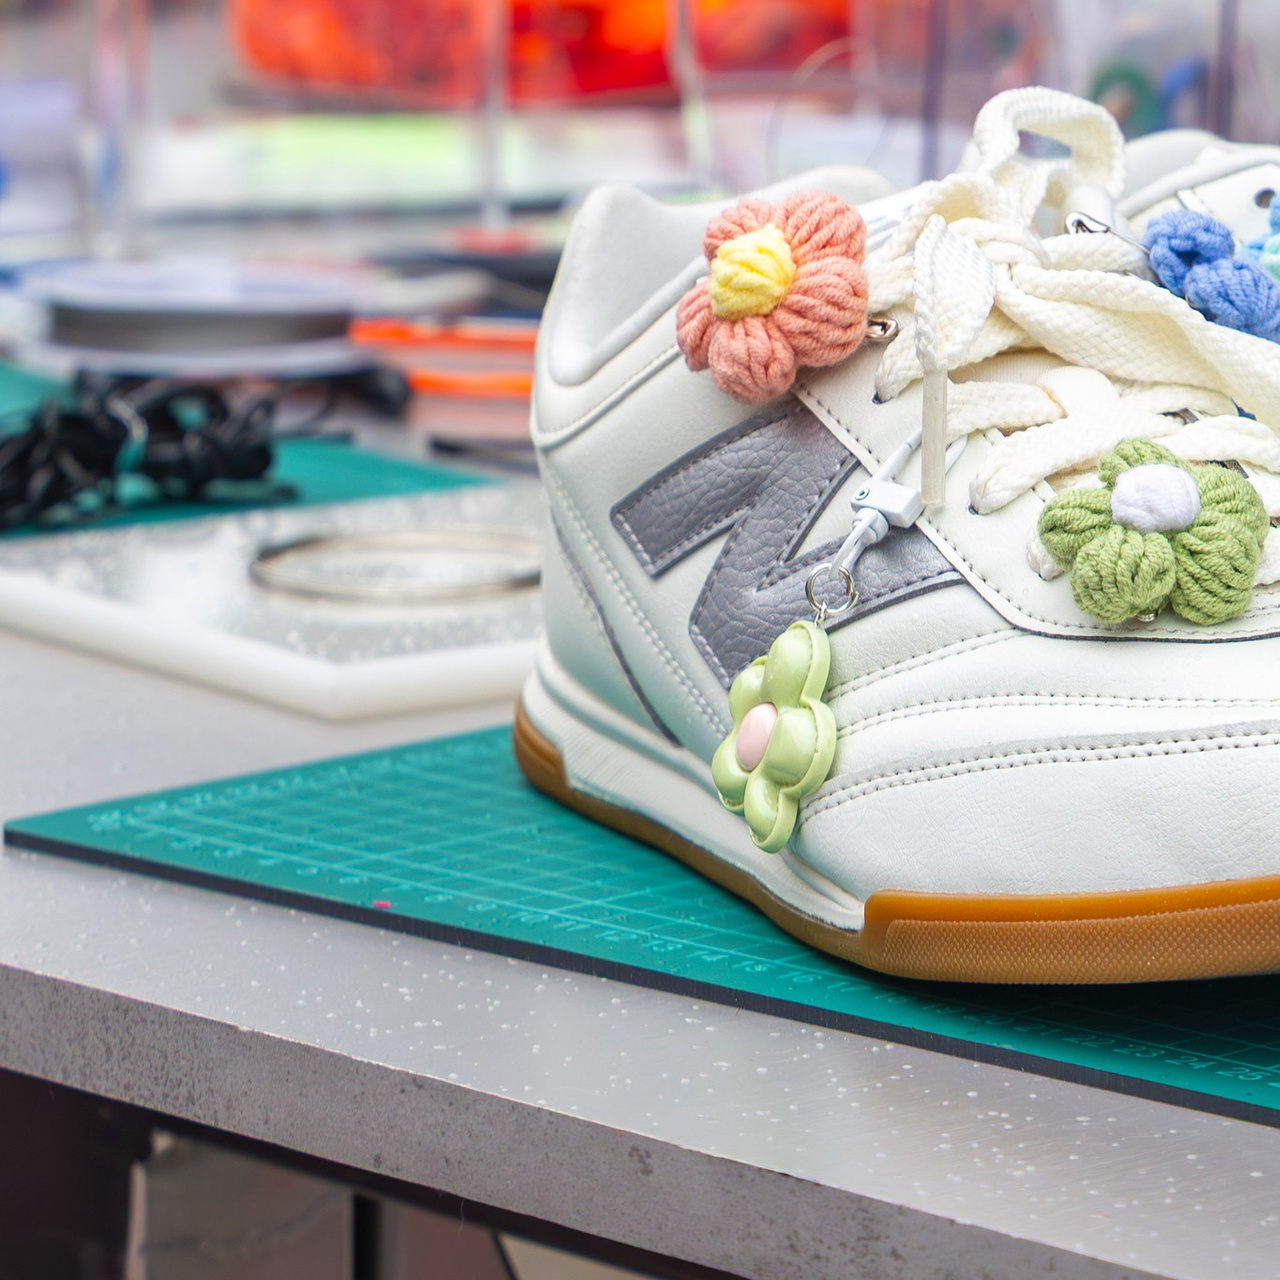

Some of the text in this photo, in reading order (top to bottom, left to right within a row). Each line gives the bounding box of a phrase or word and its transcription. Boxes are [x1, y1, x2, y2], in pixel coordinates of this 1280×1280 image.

[609, 397, 966, 690] N
[962, 1014, 1015, 1025] 20
[1013, 1023, 1063, 1036] 21
[1061, 1034, 1116, 1048] 22
[1112, 1044, 1166, 1058] 23
[1164, 1055, 1217, 1069] 24
[1215, 1067, 1272, 1081] 25
